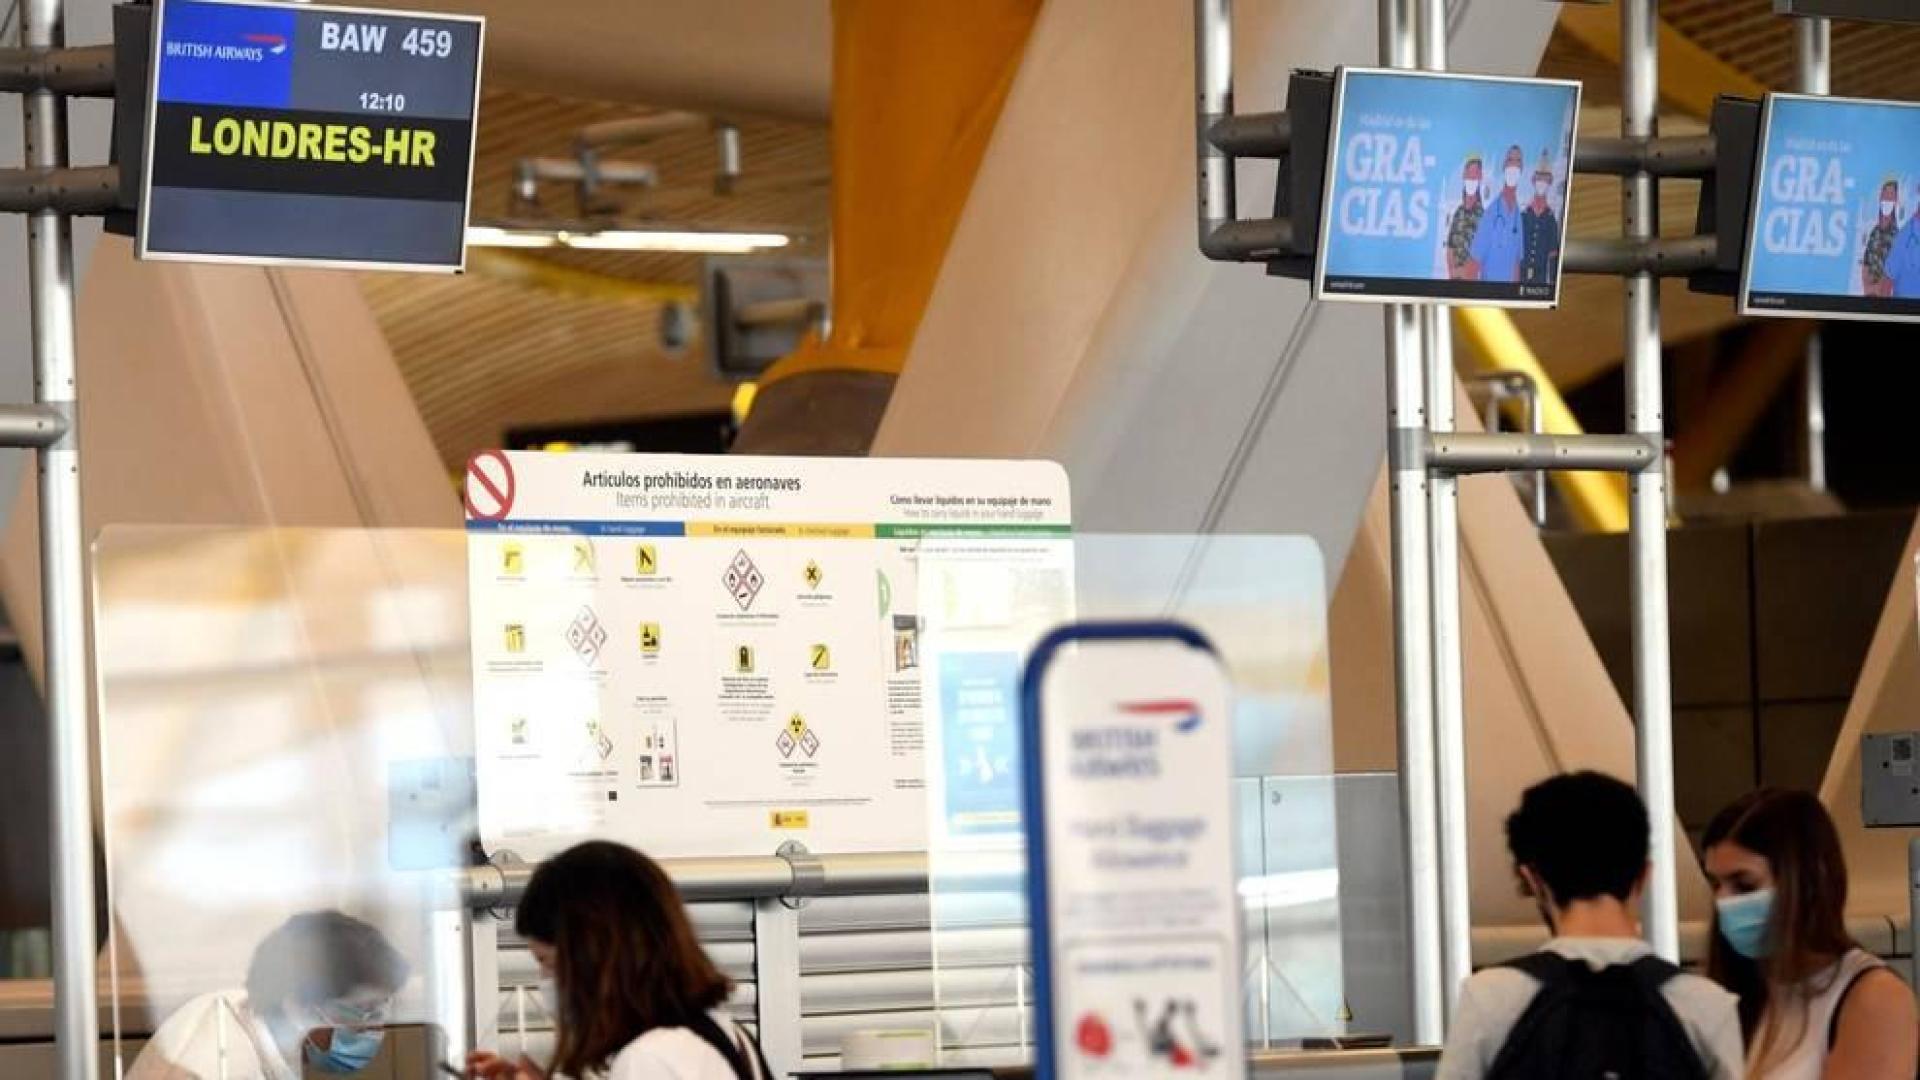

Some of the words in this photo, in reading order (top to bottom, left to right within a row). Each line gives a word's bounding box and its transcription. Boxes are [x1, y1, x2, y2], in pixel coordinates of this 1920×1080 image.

[166, 41, 212, 58] BRITISH
[214, 45, 263, 62] AIRWAYS
[321, 22, 387, 53] BAW
[401, 28, 452, 57] 459
[359, 93, 405, 112] 12:10
[189, 116, 436, 168] LONDRES-HR
[1345, 132, 1436, 185] GRA-
[1770, 154, 1855, 205] GRA-
[1339, 186, 1430, 239] CIAS
[1764, 206, 1849, 257] CIAS
[616, 491, 648, 508] Items
[651, 491, 711, 511] prohibited
[715, 493, 726, 509] in
[729, 491, 769, 509] aircraft
[643, 471, 712, 491] prohibidos
[716, 475, 732, 488] en
[736, 474, 801, 491] aeronaves
